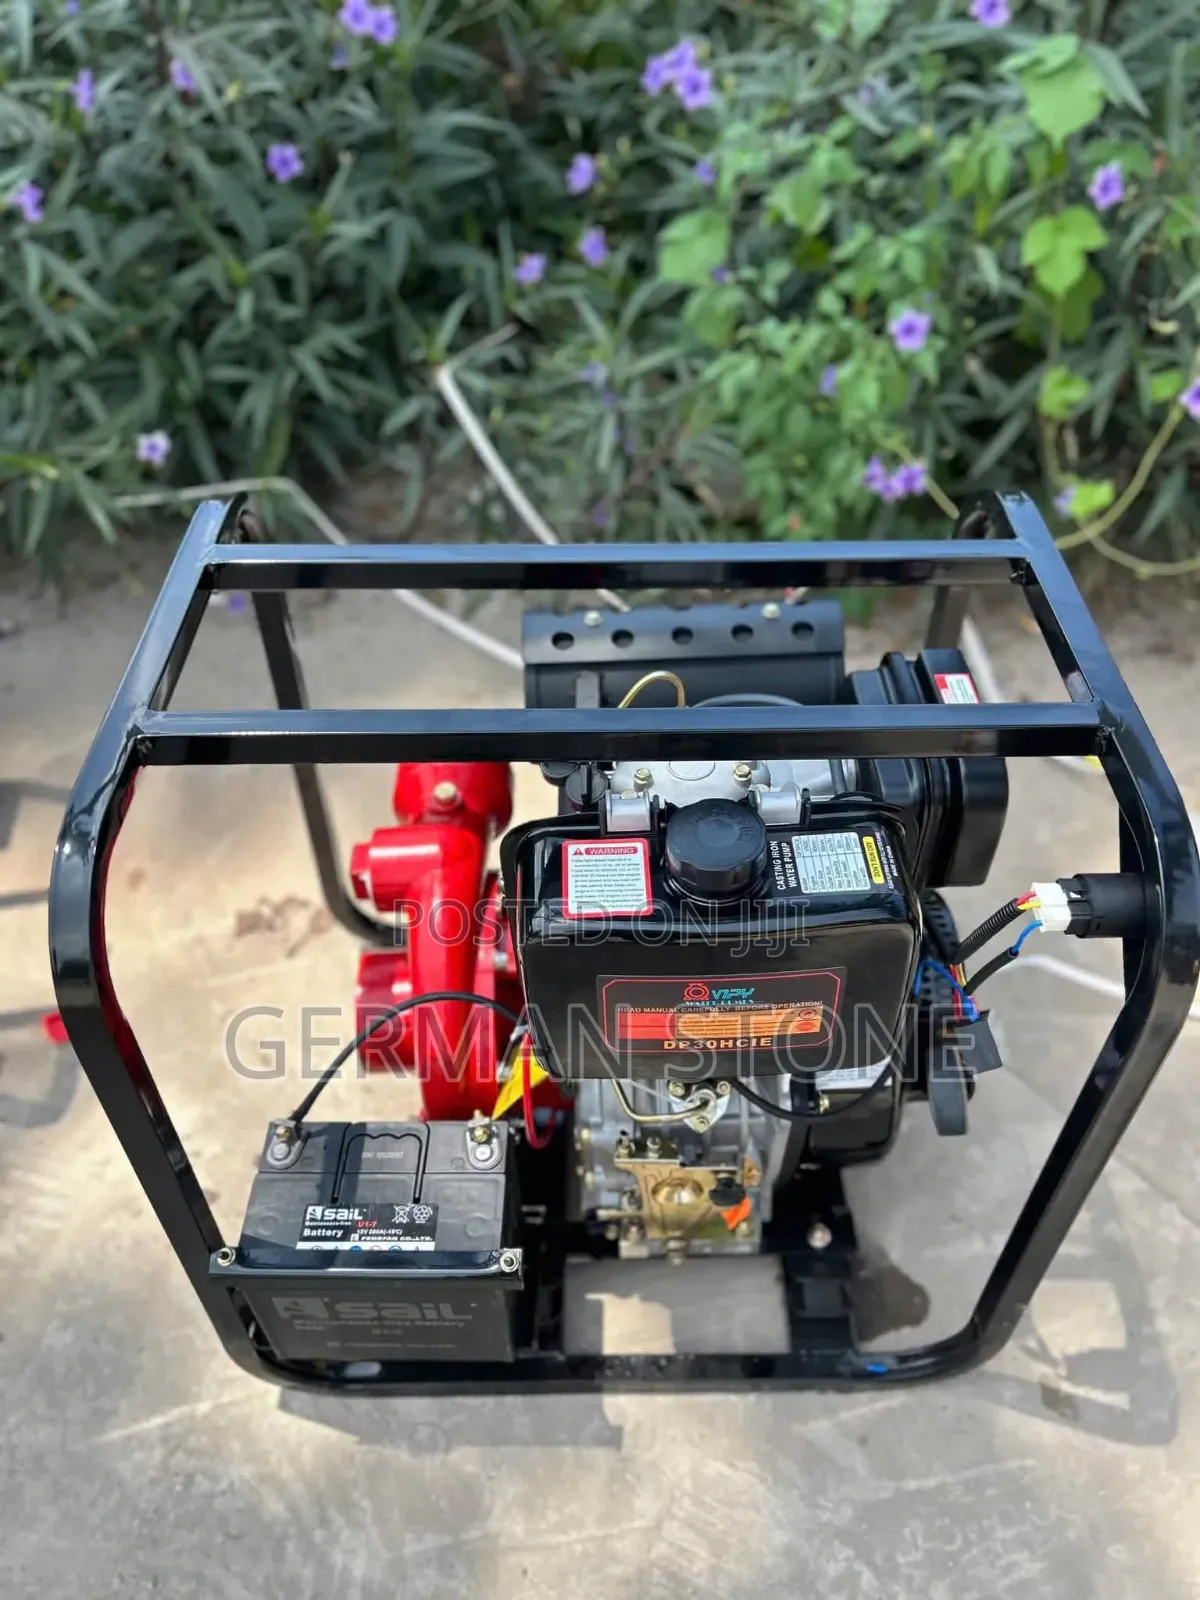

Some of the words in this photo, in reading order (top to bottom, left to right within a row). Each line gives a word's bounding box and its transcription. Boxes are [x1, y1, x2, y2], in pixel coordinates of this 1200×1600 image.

[588, 846, 635, 855] WARNING
[769, 840, 780, 857] IRON
[781, 842, 793, 862] PUMP
[773, 858, 787, 890] CASTING
[785, 862, 798, 888] WATER
[681, 1004, 730, 1013] CAREFULLY
[302, 1228, 344, 1238] Battery
